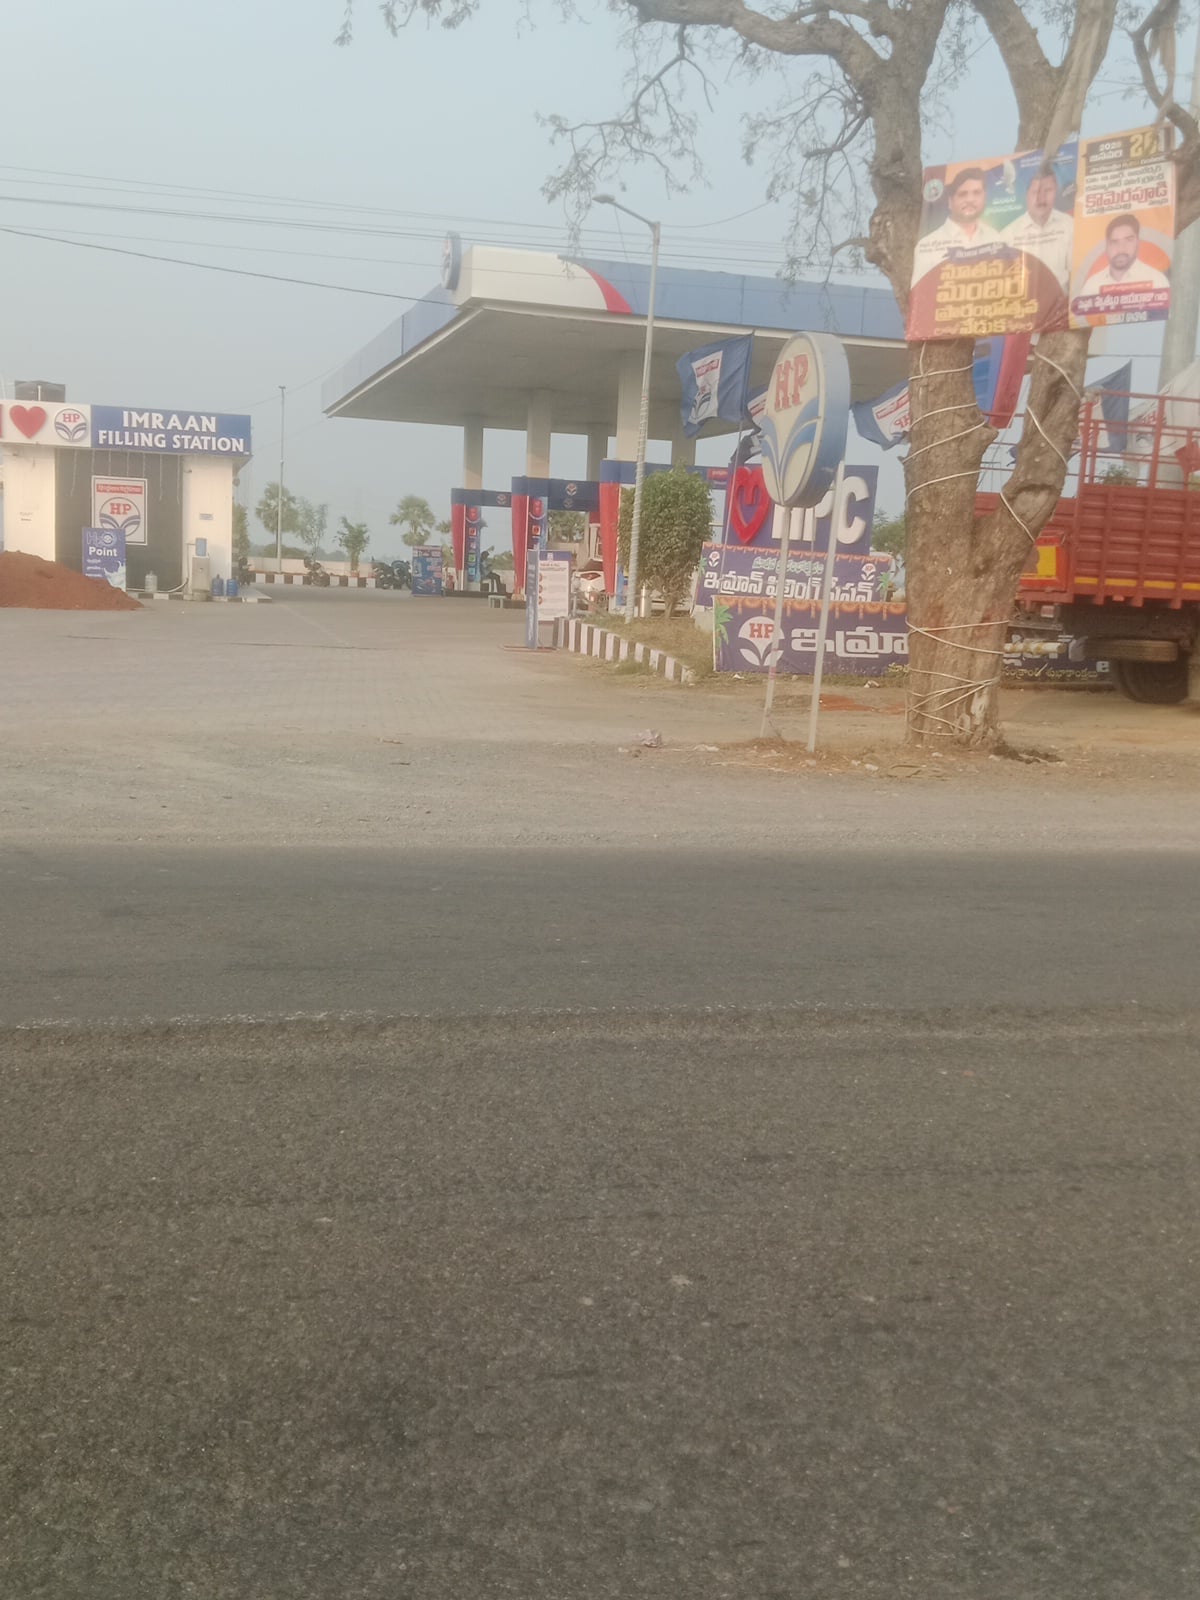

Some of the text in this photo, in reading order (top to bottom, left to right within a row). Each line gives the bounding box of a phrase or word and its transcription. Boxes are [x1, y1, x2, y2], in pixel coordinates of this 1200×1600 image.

[774, 352, 810, 413] HP
[63, 413, 80, 423] HP
[122, 410, 217, 433] IMRAAN
[98, 430, 244, 453] FILLING STATION
[109, 503, 132, 515] HP
[88, 546, 118, 557] Point
[749, 622, 775, 639] HP
